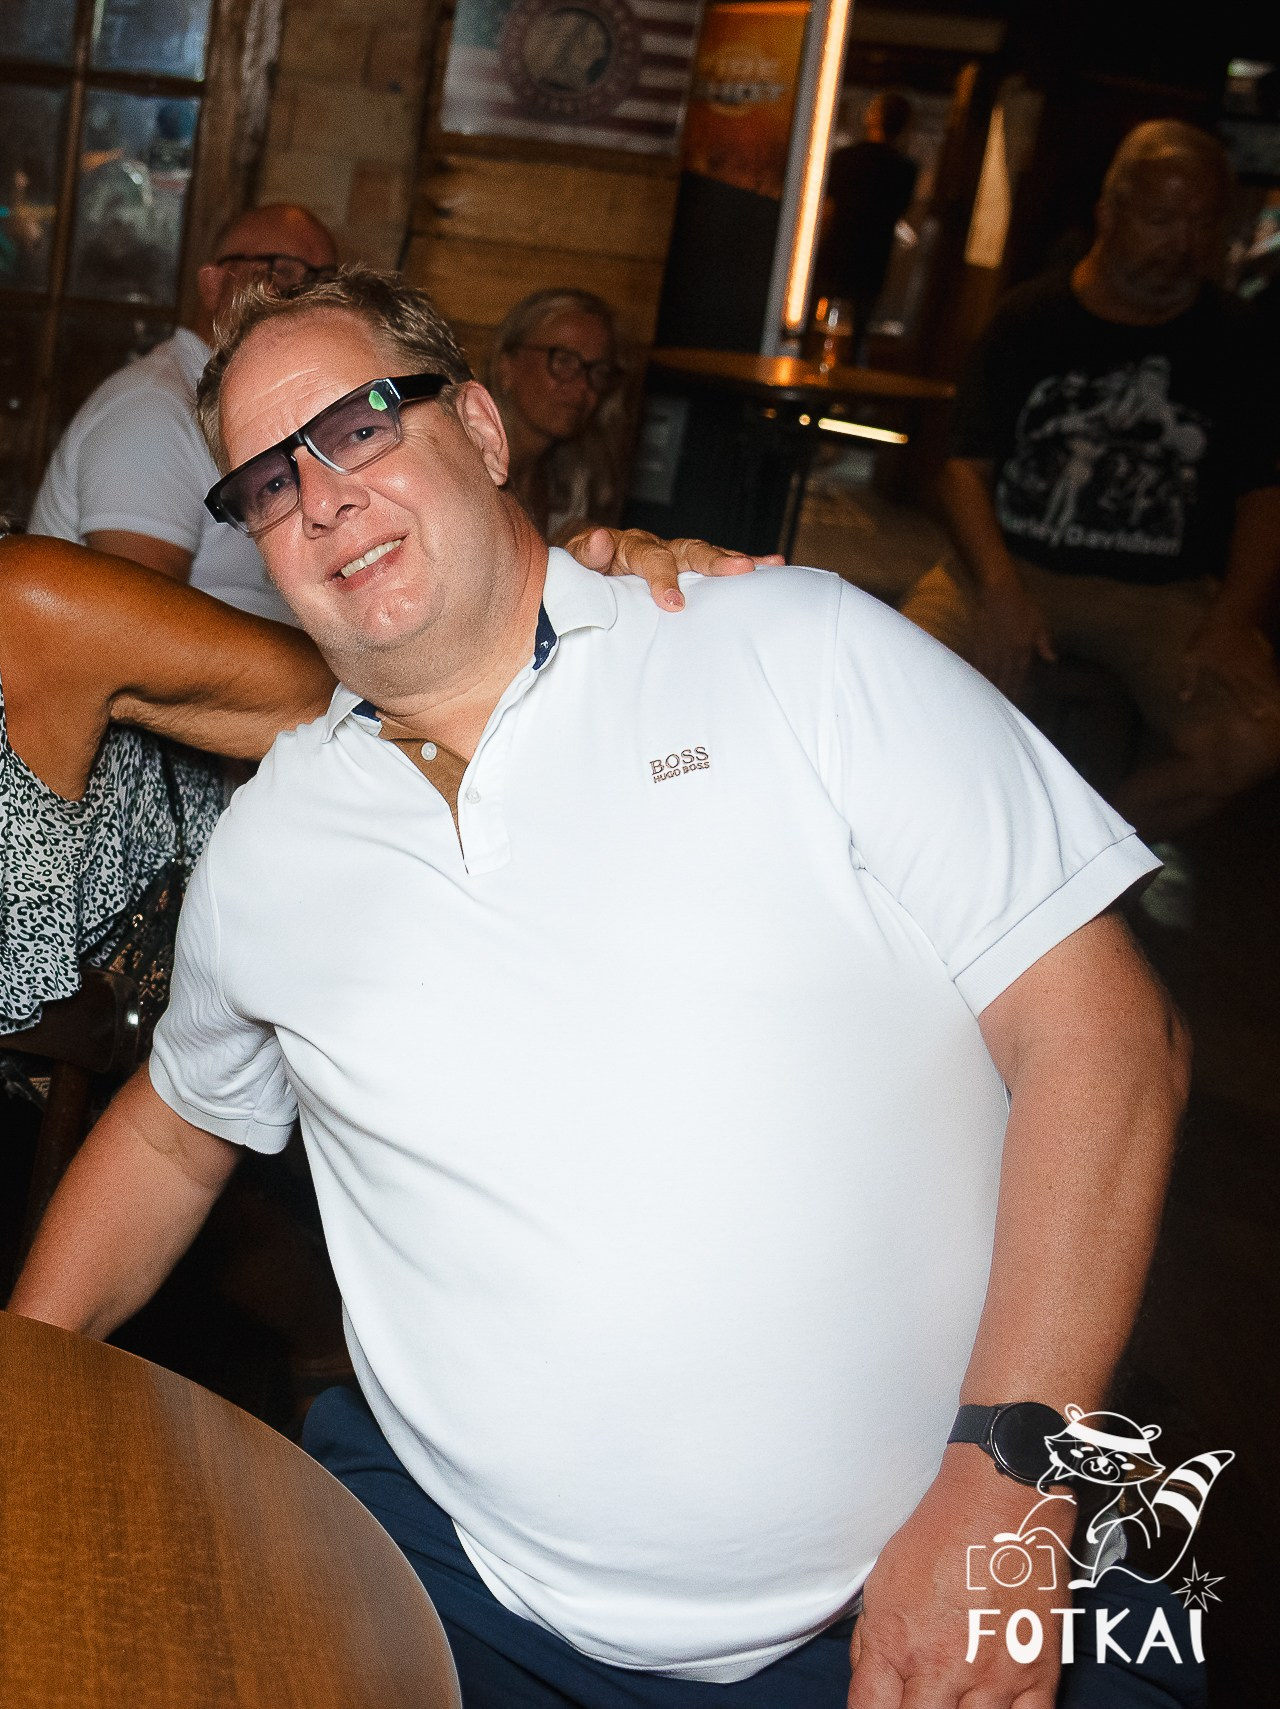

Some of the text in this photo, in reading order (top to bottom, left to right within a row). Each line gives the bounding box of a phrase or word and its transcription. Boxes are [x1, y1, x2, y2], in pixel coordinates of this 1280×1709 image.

[649, 746, 709, 775] BOSS
[653, 761, 710, 784] HUGO BOSS
